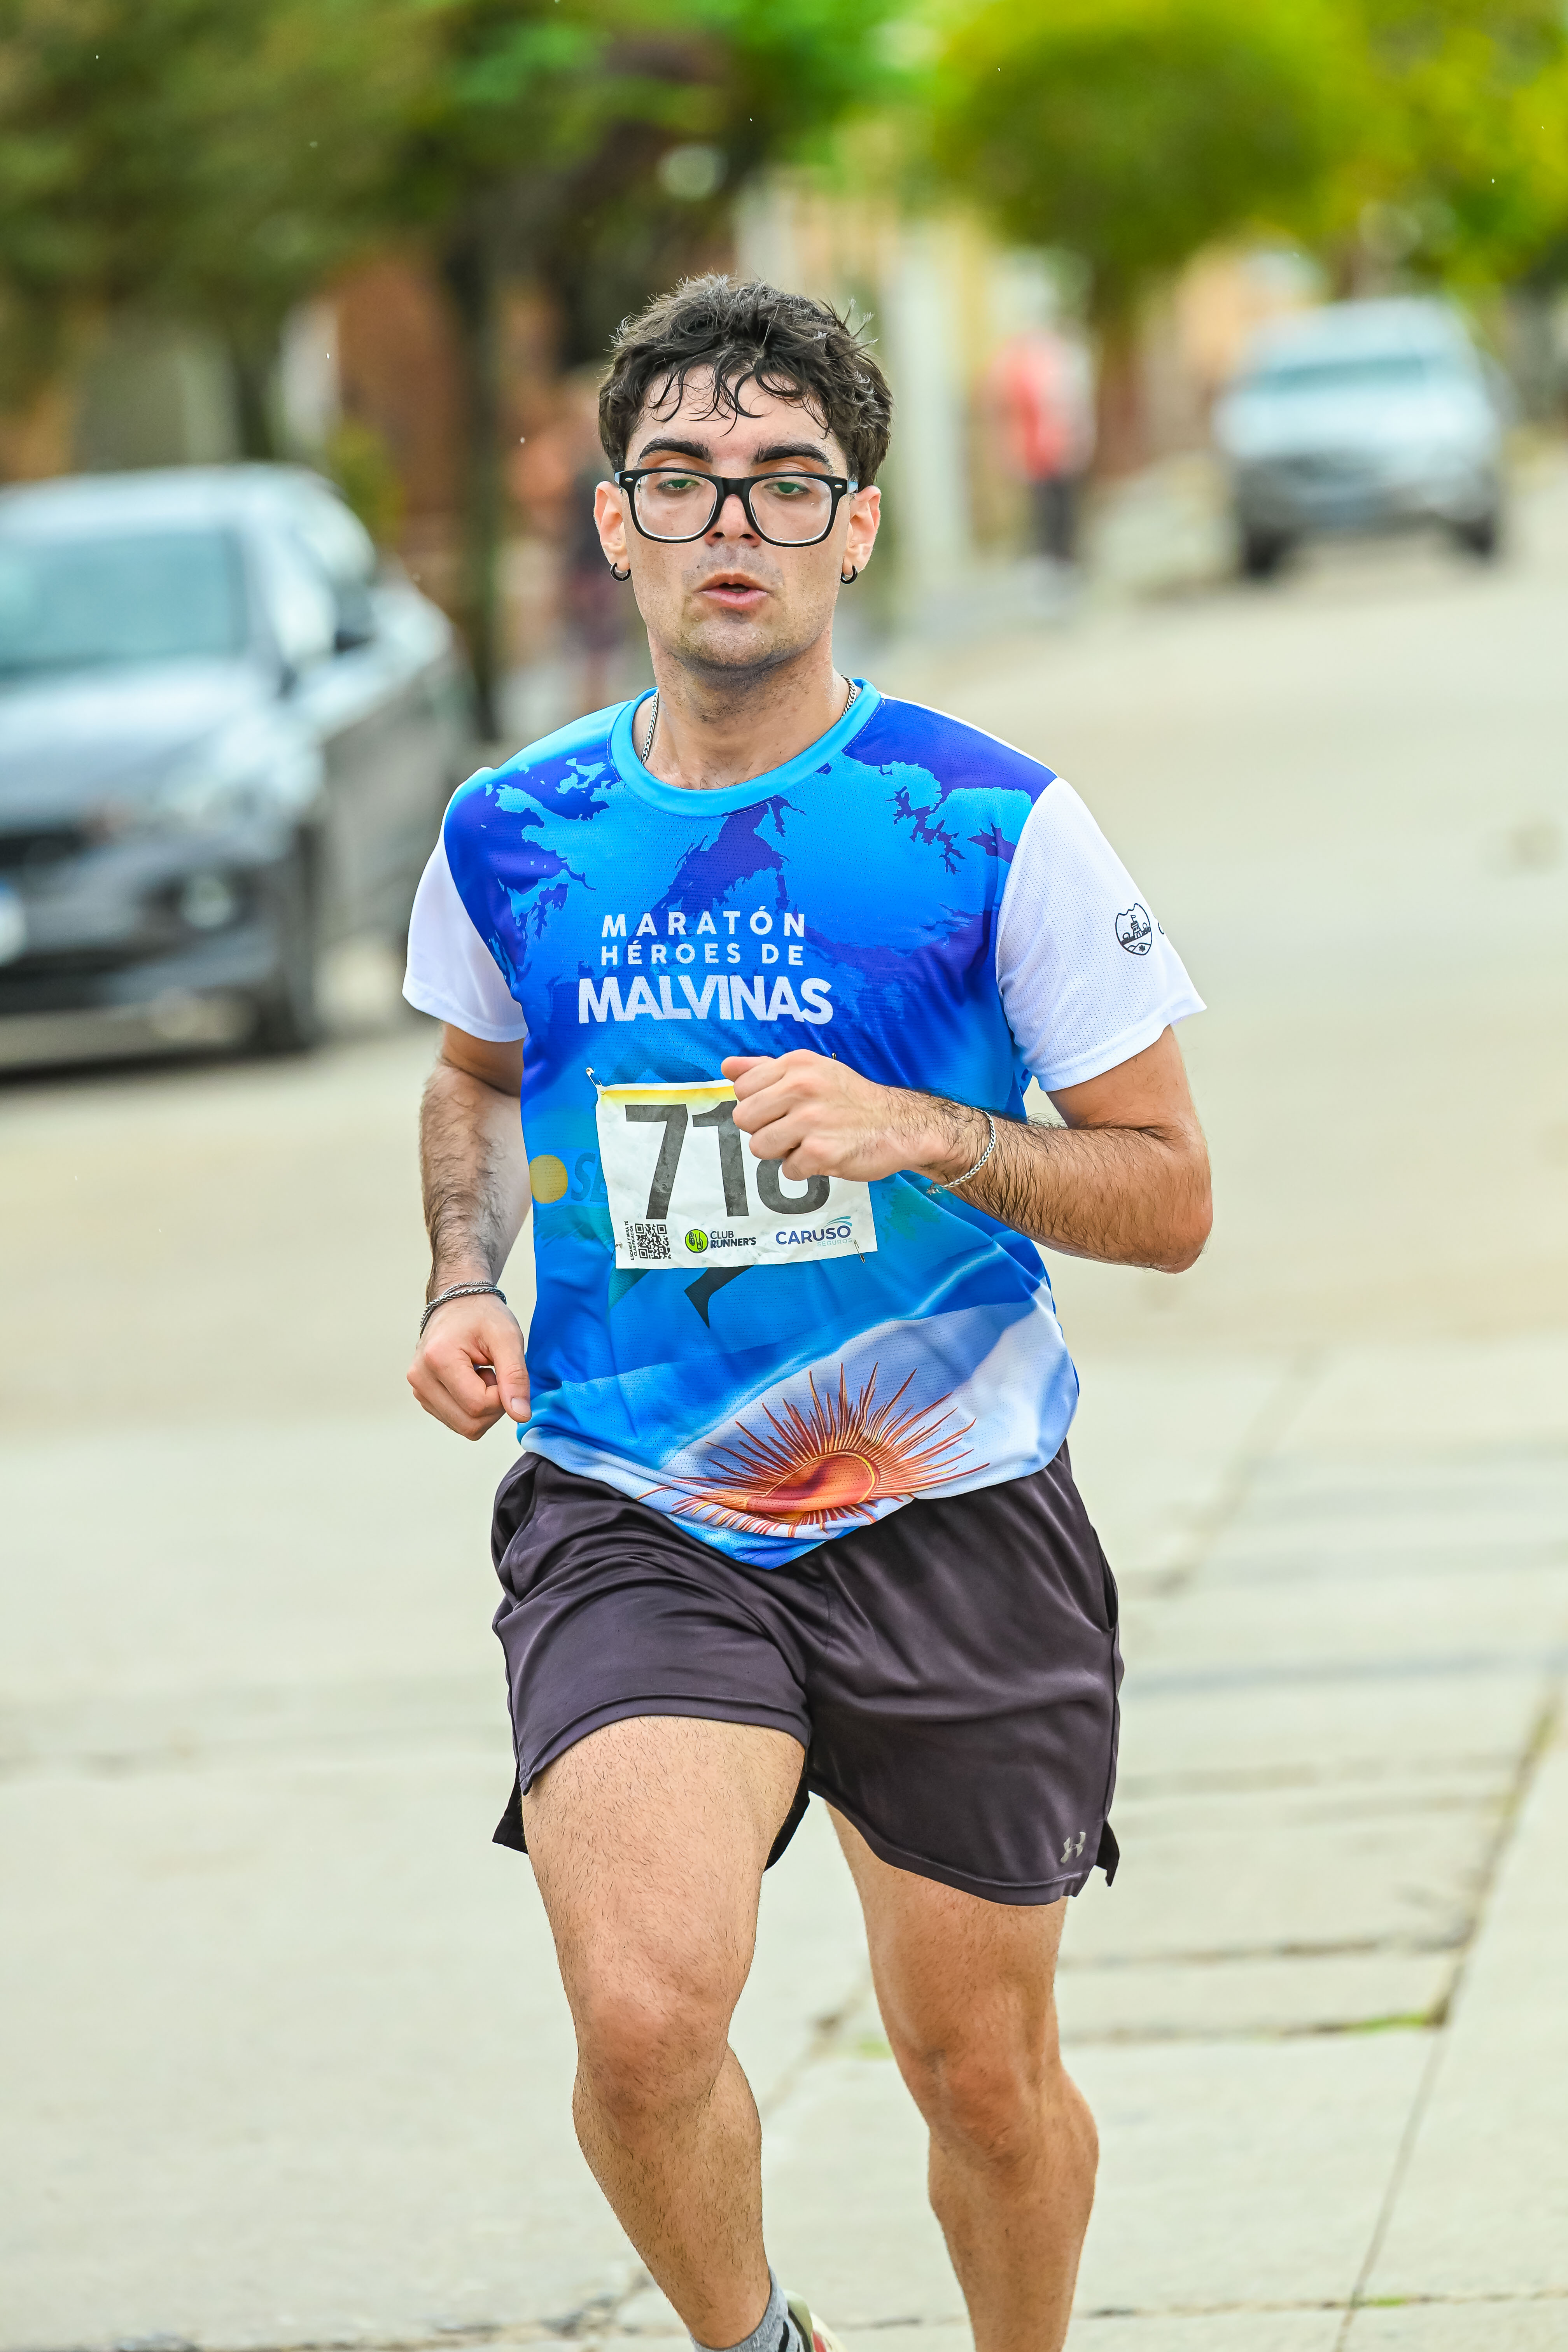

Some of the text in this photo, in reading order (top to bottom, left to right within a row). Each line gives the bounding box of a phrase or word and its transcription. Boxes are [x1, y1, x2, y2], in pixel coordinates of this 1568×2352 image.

[602, 906, 805, 938] MARATÓN
[601, 940, 804, 966] HÉROES DE
[579, 975, 833, 1024] MALVINAS
[710, 1230, 734, 1239] CLUB
[710, 1237, 756, 1249] RUNNER'S
[775, 1225, 851, 1245] CARUSO
[817, 1238, 852, 1246] SEGUROS
